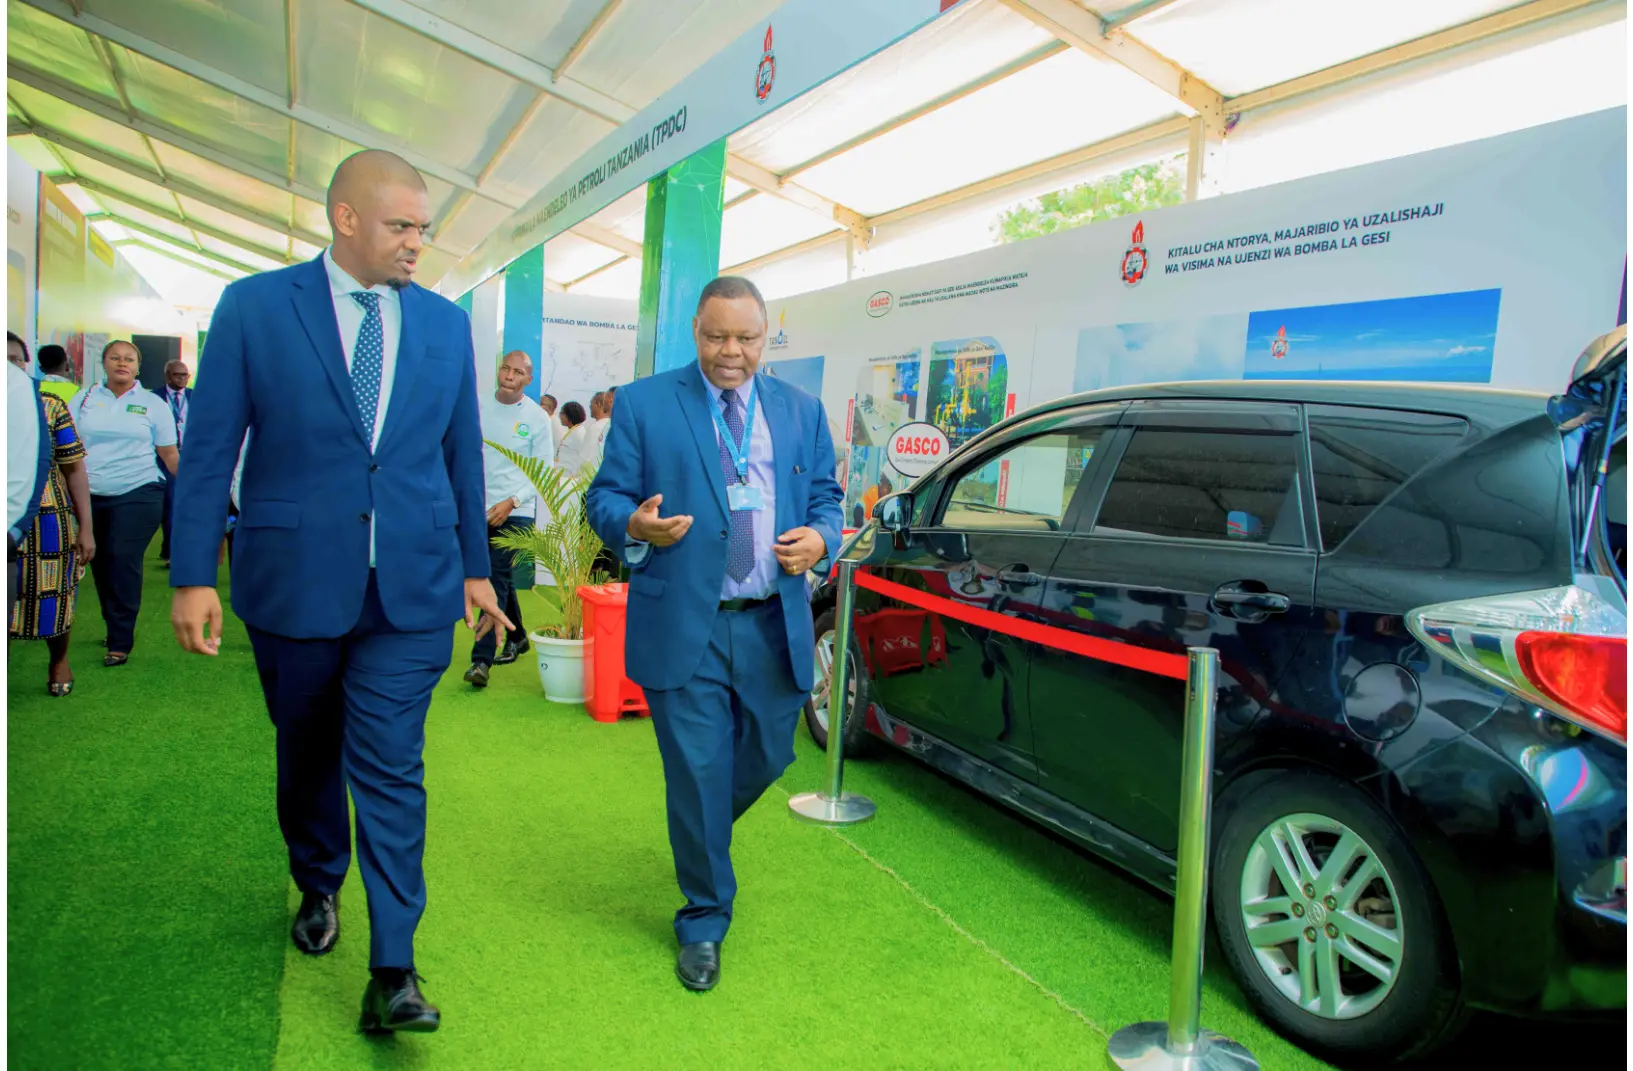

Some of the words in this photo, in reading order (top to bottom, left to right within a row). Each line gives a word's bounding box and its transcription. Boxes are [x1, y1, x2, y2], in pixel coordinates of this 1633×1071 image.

[569, 184, 577, 204] YA
[578, 164, 606, 197] PETROLI
[607, 133, 649, 178] TANZANIA
[652, 104, 687, 151] (TPDC)
[1168, 243, 1202, 259] KITALU
[1203, 240, 1224, 253] CHA
[1226, 232, 1271, 249] NTORYA,
[1274, 221, 1340, 242] MAJARIBIO
[1343, 217, 1358, 230] YA
[1362, 202, 1444, 228] UZALISHAJI
[1164, 263, 1179, 274] WA
[1182, 258, 1215, 272] VISIMA
[1217, 255, 1232, 267] NA
[1235, 249, 1271, 264] UJENZI
[1274, 246, 1291, 259] WA
[1294, 239, 1338, 255] BOMBA
[1341, 236, 1358, 249] LA
[1361, 231, 1391, 246] GESI
[870, 296, 889, 308] GASCO
[589, 321, 615, 329] BOMBA
[895, 436, 941, 456] GASCO
